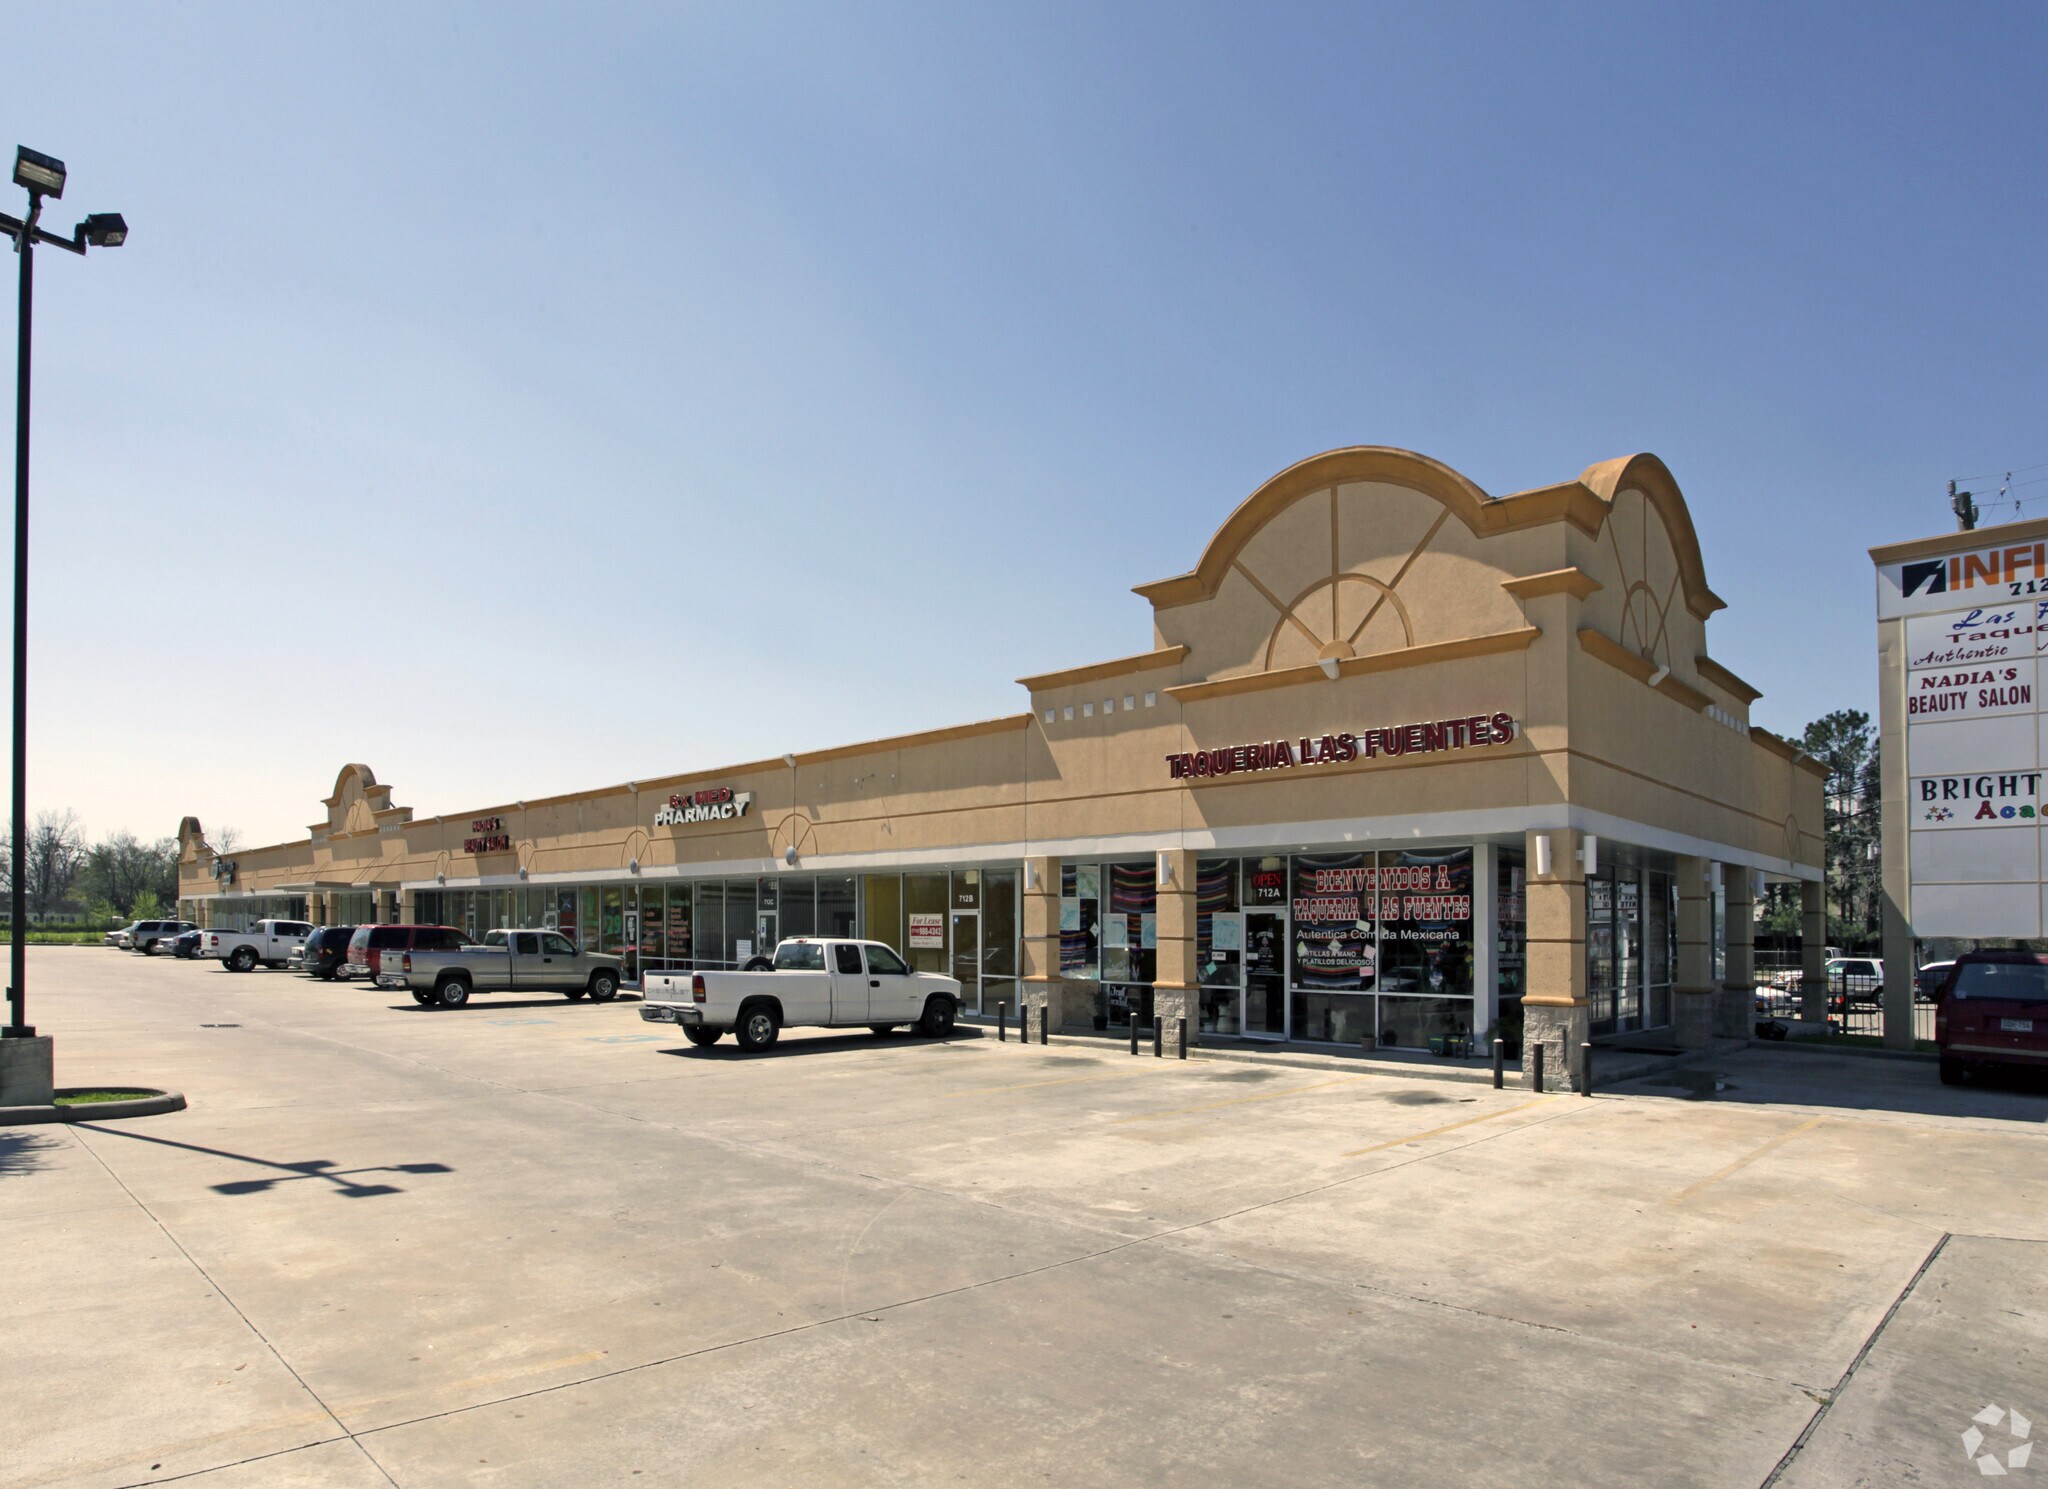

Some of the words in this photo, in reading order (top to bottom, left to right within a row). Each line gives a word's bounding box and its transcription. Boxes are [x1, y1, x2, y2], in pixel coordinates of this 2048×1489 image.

[1952, 609, 2015, 630] Las
[1913, 645, 2008, 665] Authentic
[1921, 668, 2017, 689] NADIA'S
[1909, 691, 1968, 714] BEAUTY
[1978, 685, 2031, 708] SALON
[1166, 740, 1295, 779] TAQUERIA
[1299, 732, 1358, 766] LAS
[1365, 711, 1514, 758] FUENTES
[695, 787, 732, 805] MED
[1920, 773, 2042, 801] BRIGHT
[655, 801, 748, 826] PHARMACY
[1253, 873, 1281, 886] OPEN
[1316, 866, 1431, 892] BIENVENIDOS
[1436, 865, 1450, 889] A
[1258, 888, 1280, 897] 712A
[912, 916, 922, 924] For
[923, 916, 941, 924] Lease
[1293, 897, 1360, 925] TAQUERIA
[1403, 895, 1470, 920] FUENTES
[1296, 929, 1347, 939] Autentica
[1400, 929, 1460, 940] Mexicana
